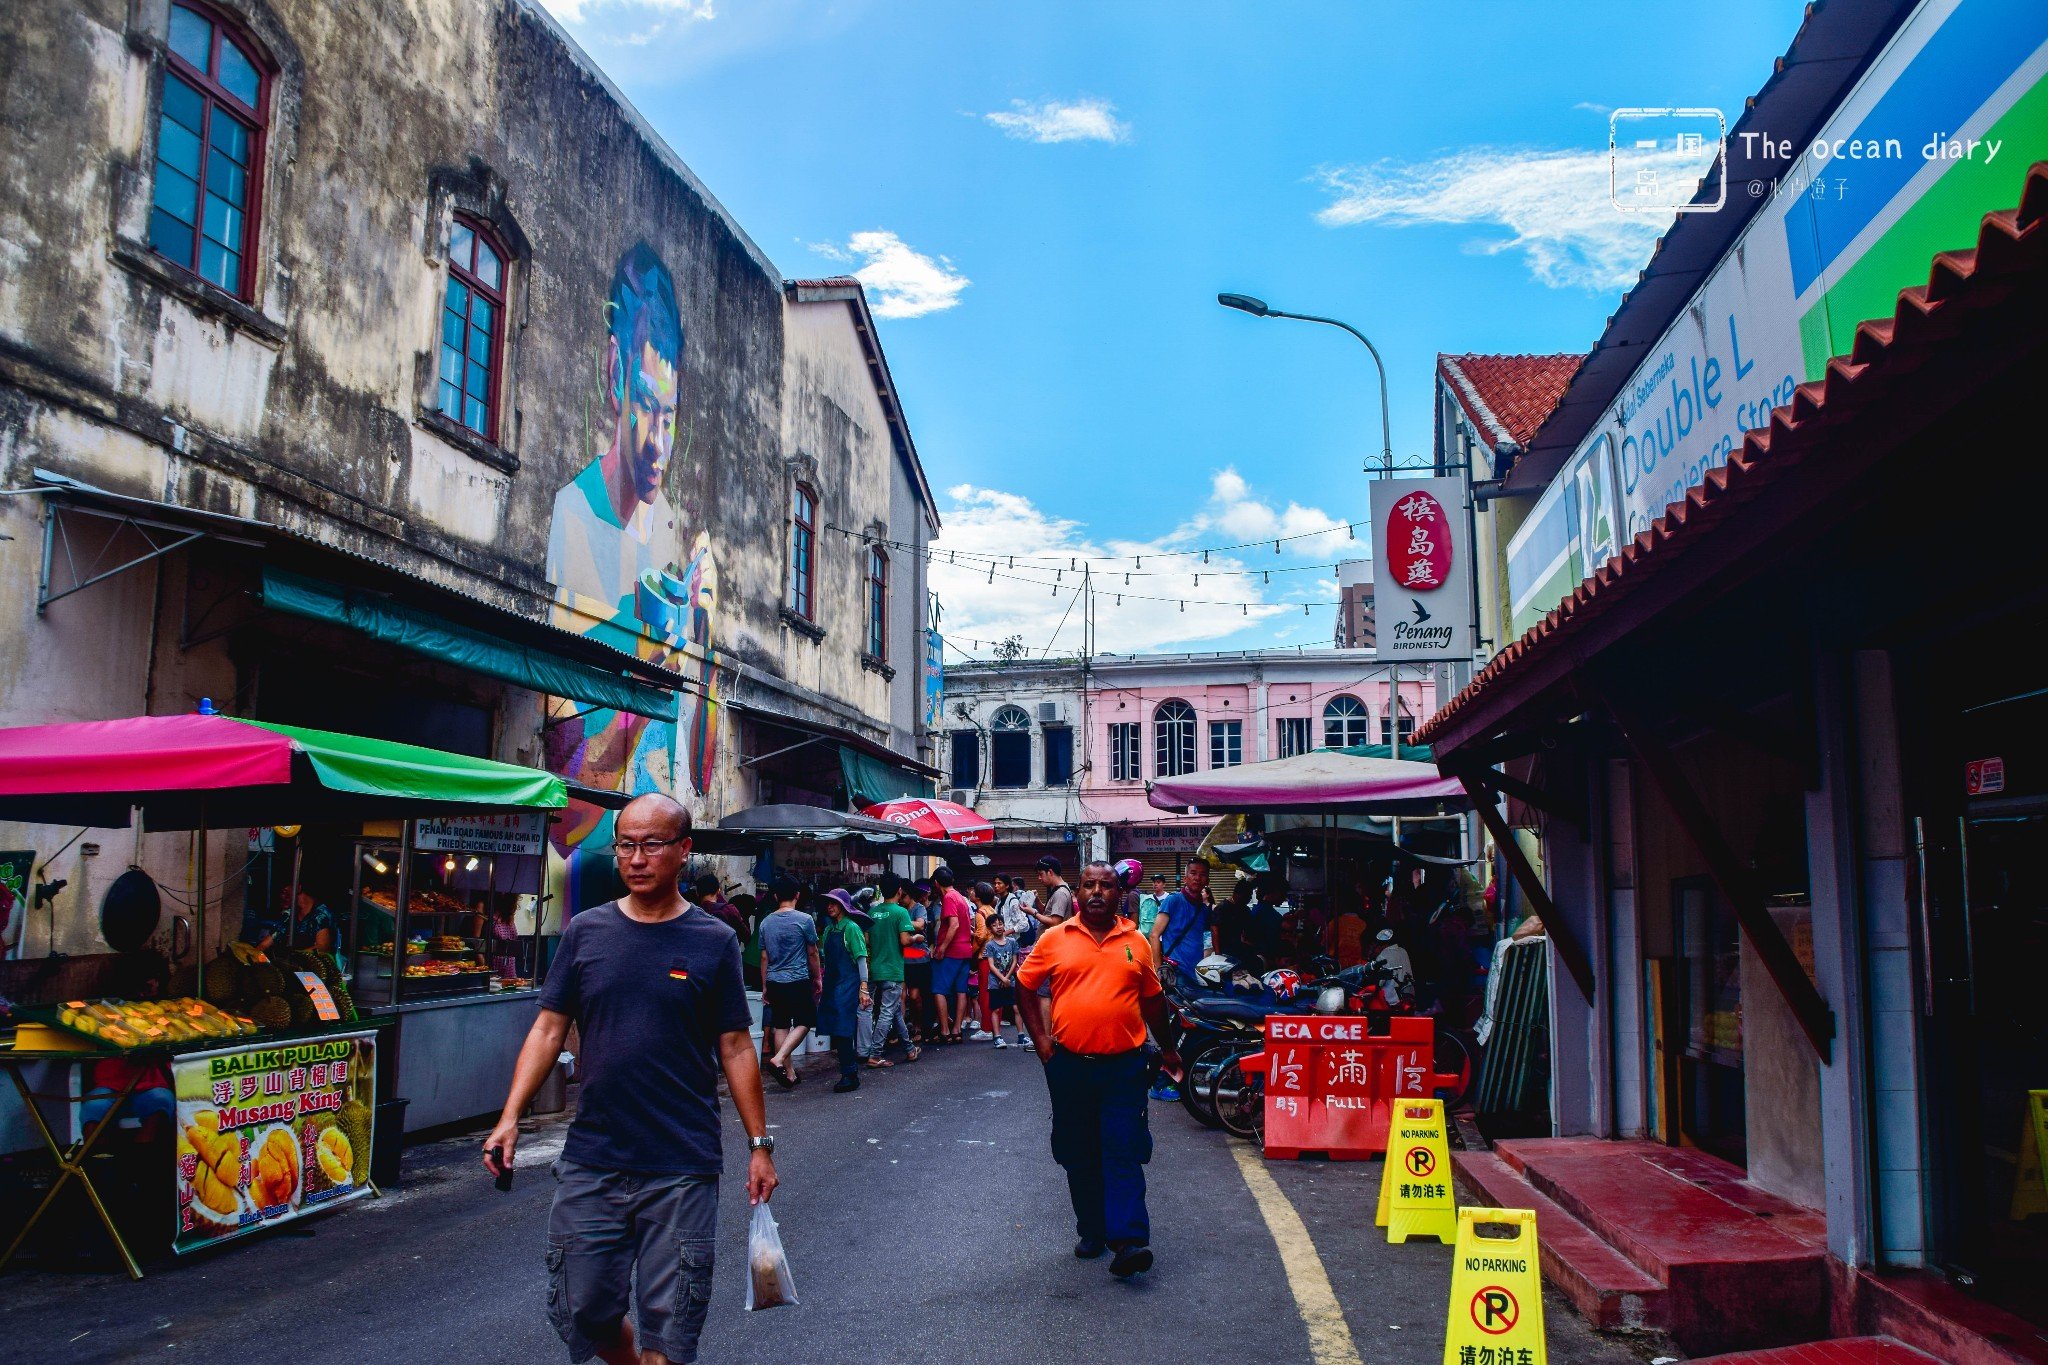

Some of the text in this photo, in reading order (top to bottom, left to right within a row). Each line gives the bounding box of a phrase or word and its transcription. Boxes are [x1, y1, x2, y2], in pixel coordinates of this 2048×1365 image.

[1621, 314, 1754, 495] Double L
[1394, 621, 1452, 648] Penang
[1393, 641, 1439, 650] BIRDNEST
[420, 824, 452, 836] PENANG
[454, 827, 474, 838] ROAD
[475, 829, 504, 840] FAMOUS
[505, 831, 514, 841] AH
[437, 838, 460, 849] FRIED
[498, 843, 511, 852] LOR
[512, 844, 526, 853] BAK
[1271, 1023, 1362, 1040] ECA C&E
[210, 1041, 350, 1077] BALIK PULAU
[218, 1090, 342, 1131] Musang King
[1401, 1130, 1439, 1139] NO PARKING
[1400, 1183, 1446, 1199] 请勿泊车
[238, 1209, 262, 1226] Black
[1465, 1258, 1526, 1273] NO PARKING
[1459, 1345, 1533, 1365] 请勿泊车
